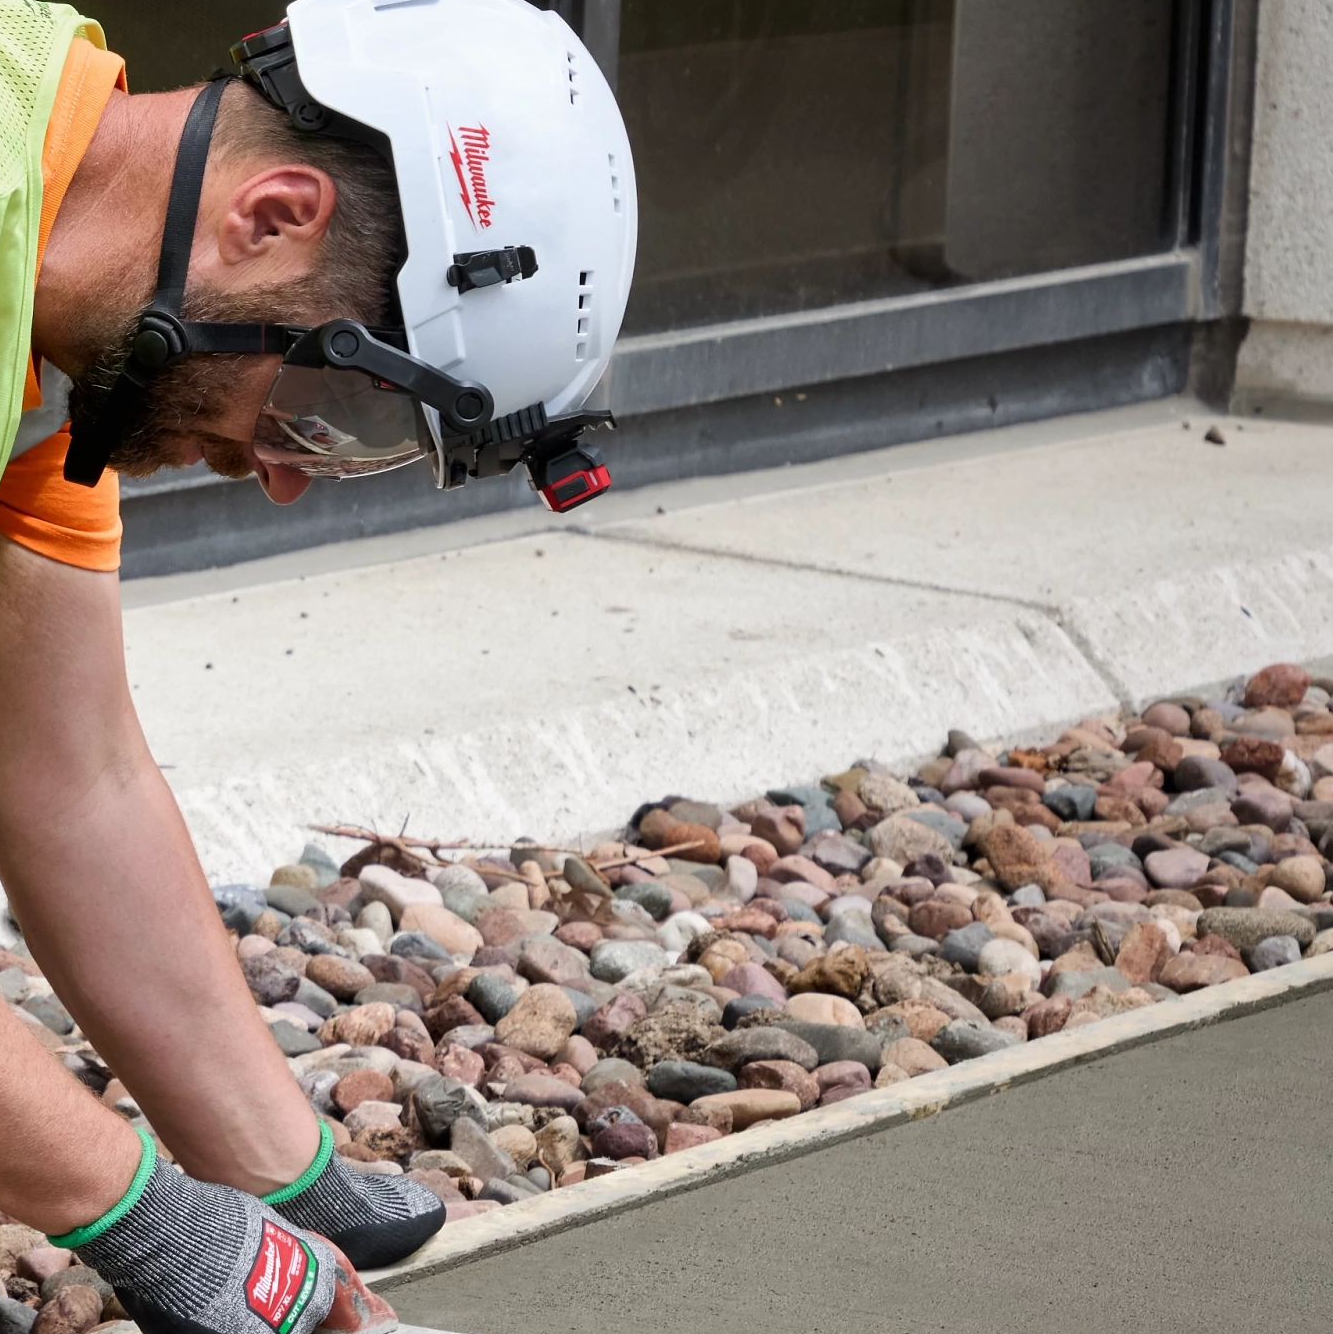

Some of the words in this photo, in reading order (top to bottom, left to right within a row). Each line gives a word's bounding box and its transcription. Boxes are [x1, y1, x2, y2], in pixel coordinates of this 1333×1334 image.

[458, 121, 495, 229] Milwaukee
[252, 1240, 275, 1303] Milwaukee
[283, 1295, 293, 1306] XL
[287, 1304, 300, 1323] CUT
[298, 1280, 313, 1305] LEVEL
